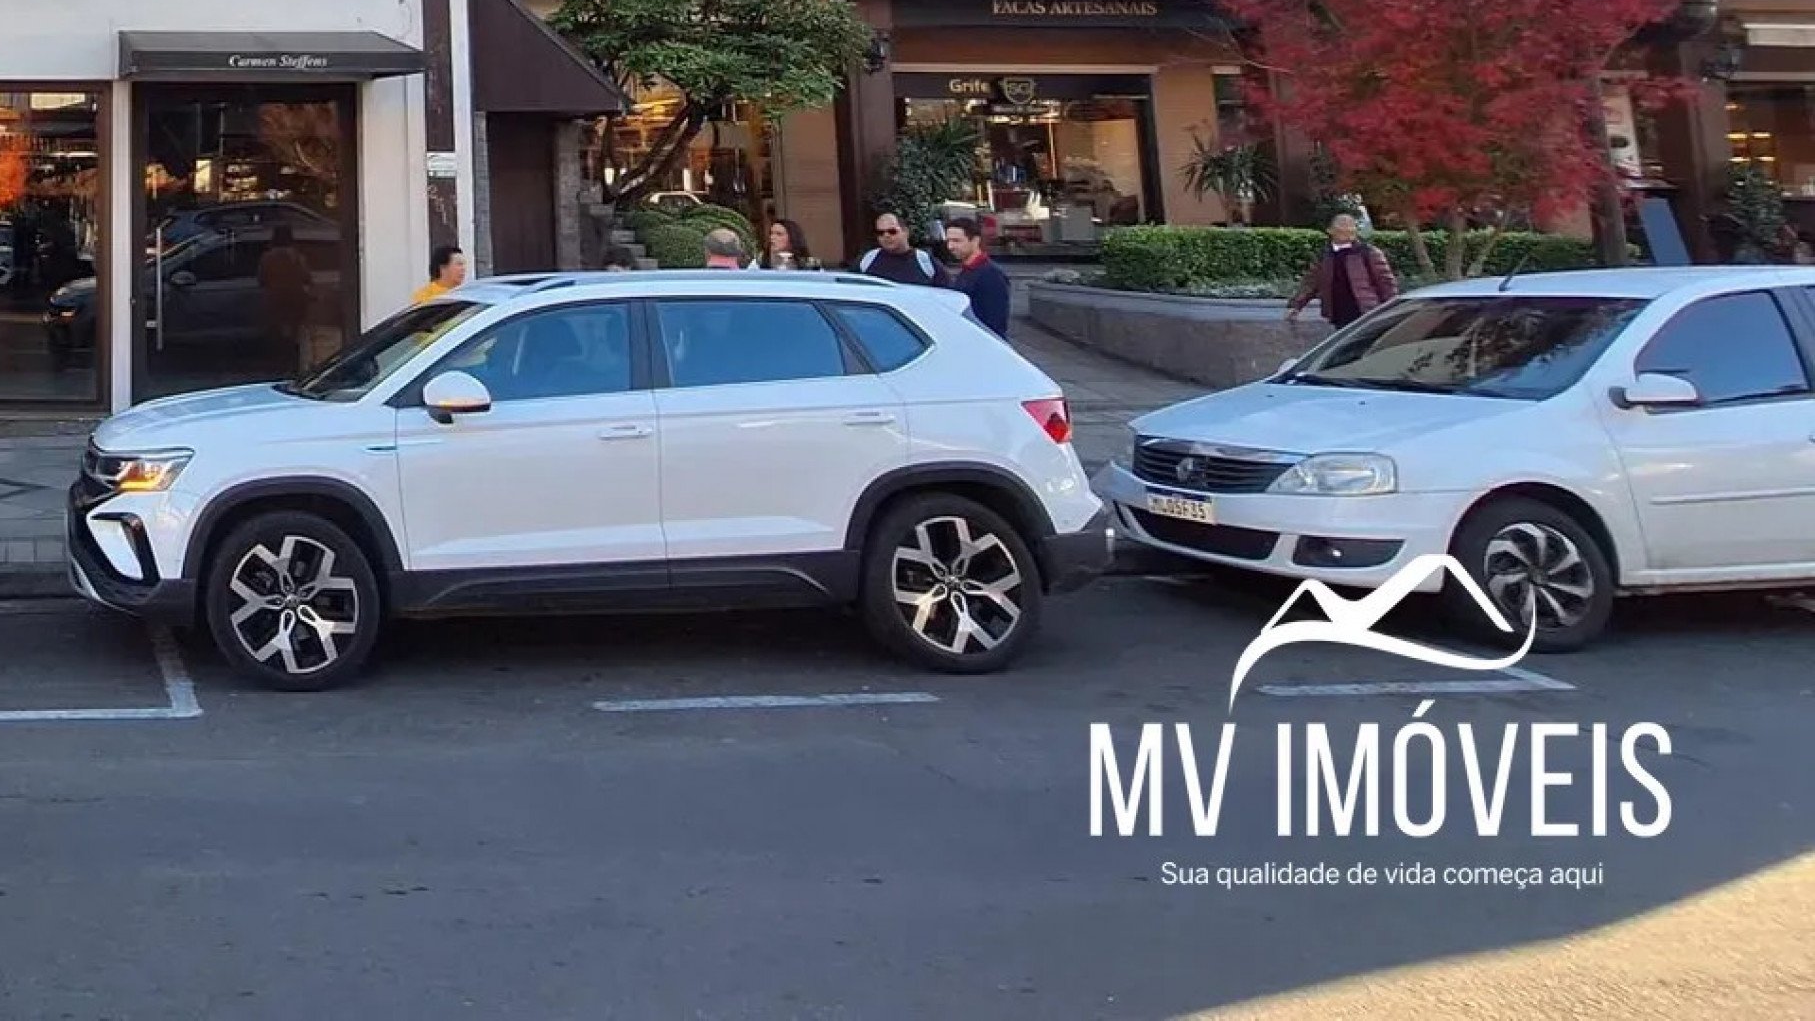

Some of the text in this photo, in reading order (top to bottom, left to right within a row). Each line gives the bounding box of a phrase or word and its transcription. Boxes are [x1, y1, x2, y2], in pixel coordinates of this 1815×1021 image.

[992, 0, 1158, 16] FACAS ARTESANAIS
[229, 54, 328, 69] Carmen Steffens
